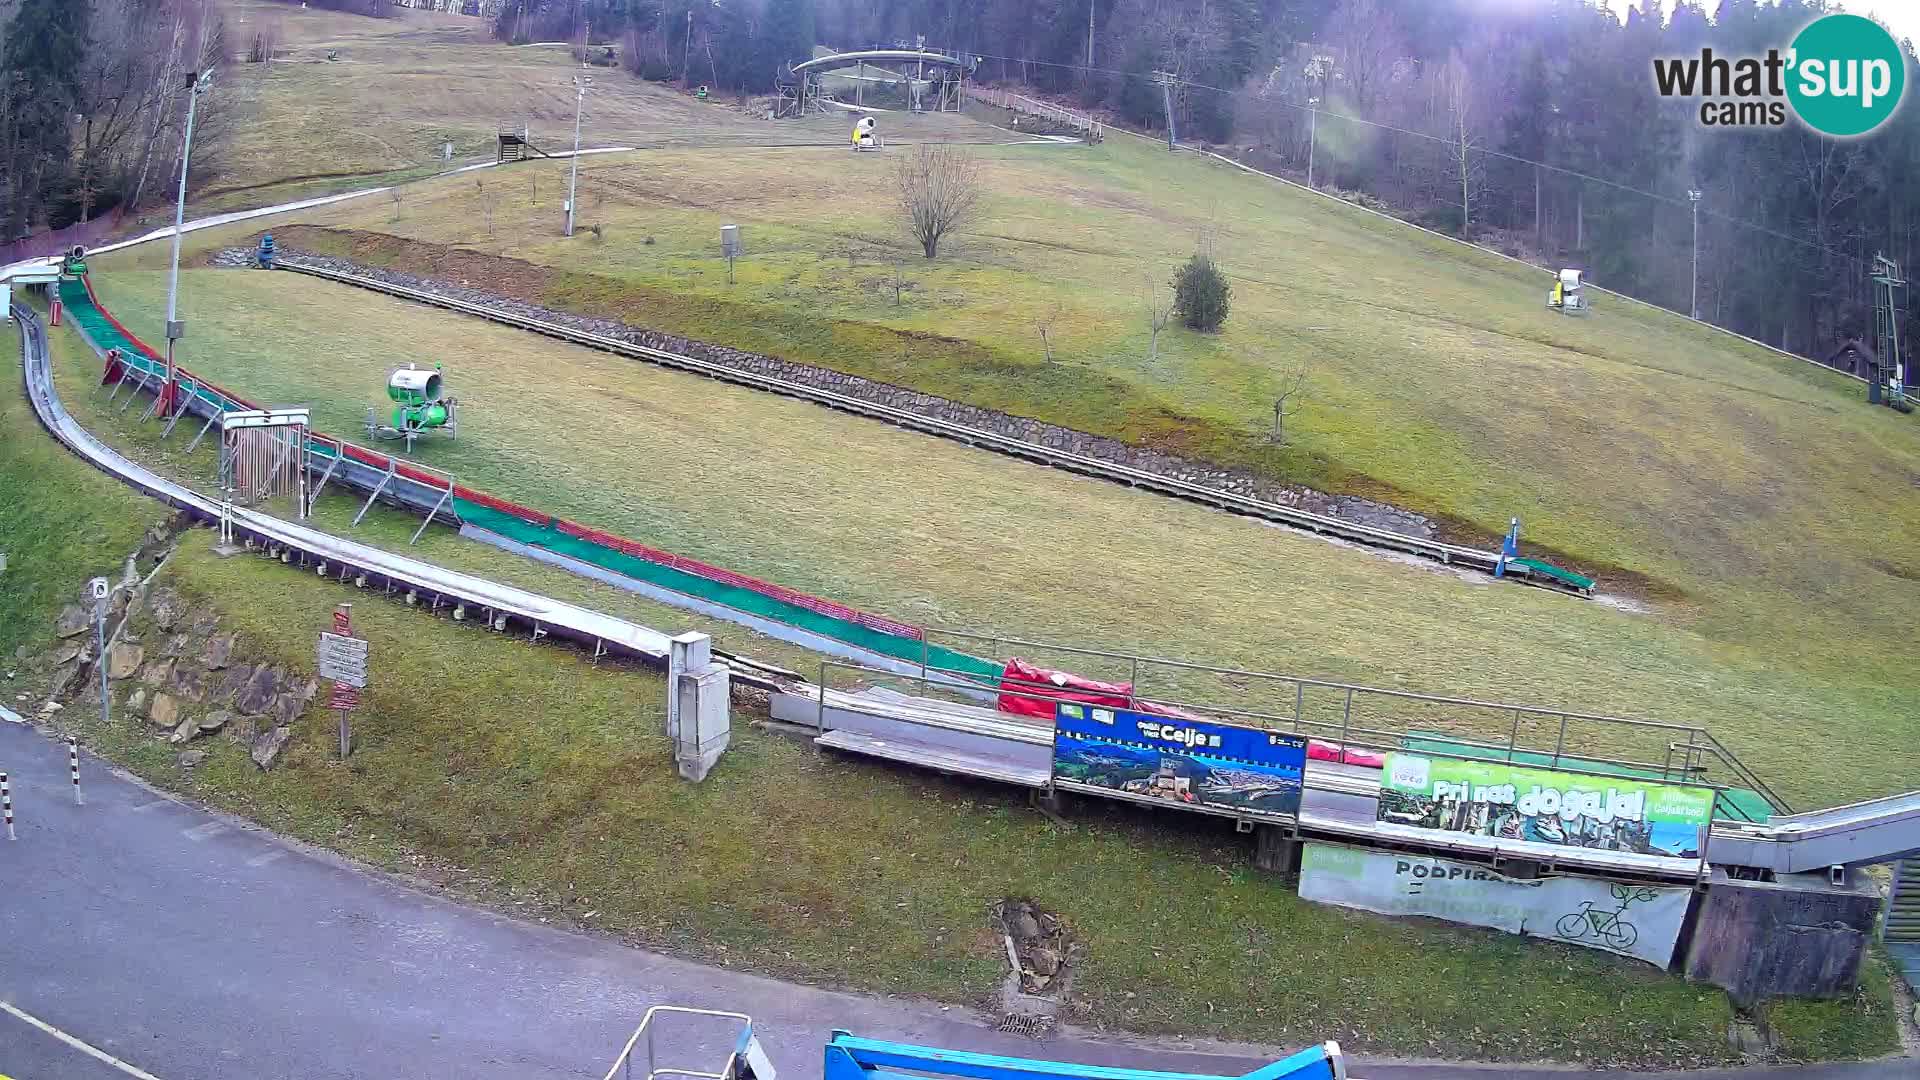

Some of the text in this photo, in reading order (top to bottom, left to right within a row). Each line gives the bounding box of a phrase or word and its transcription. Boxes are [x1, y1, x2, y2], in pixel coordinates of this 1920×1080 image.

[1160, 725, 1207, 747] Celje
[1432, 780, 1469, 803] Pri
[1473, 783, 1516, 805] nas
[1396, 860, 1544, 887] PODPIR
